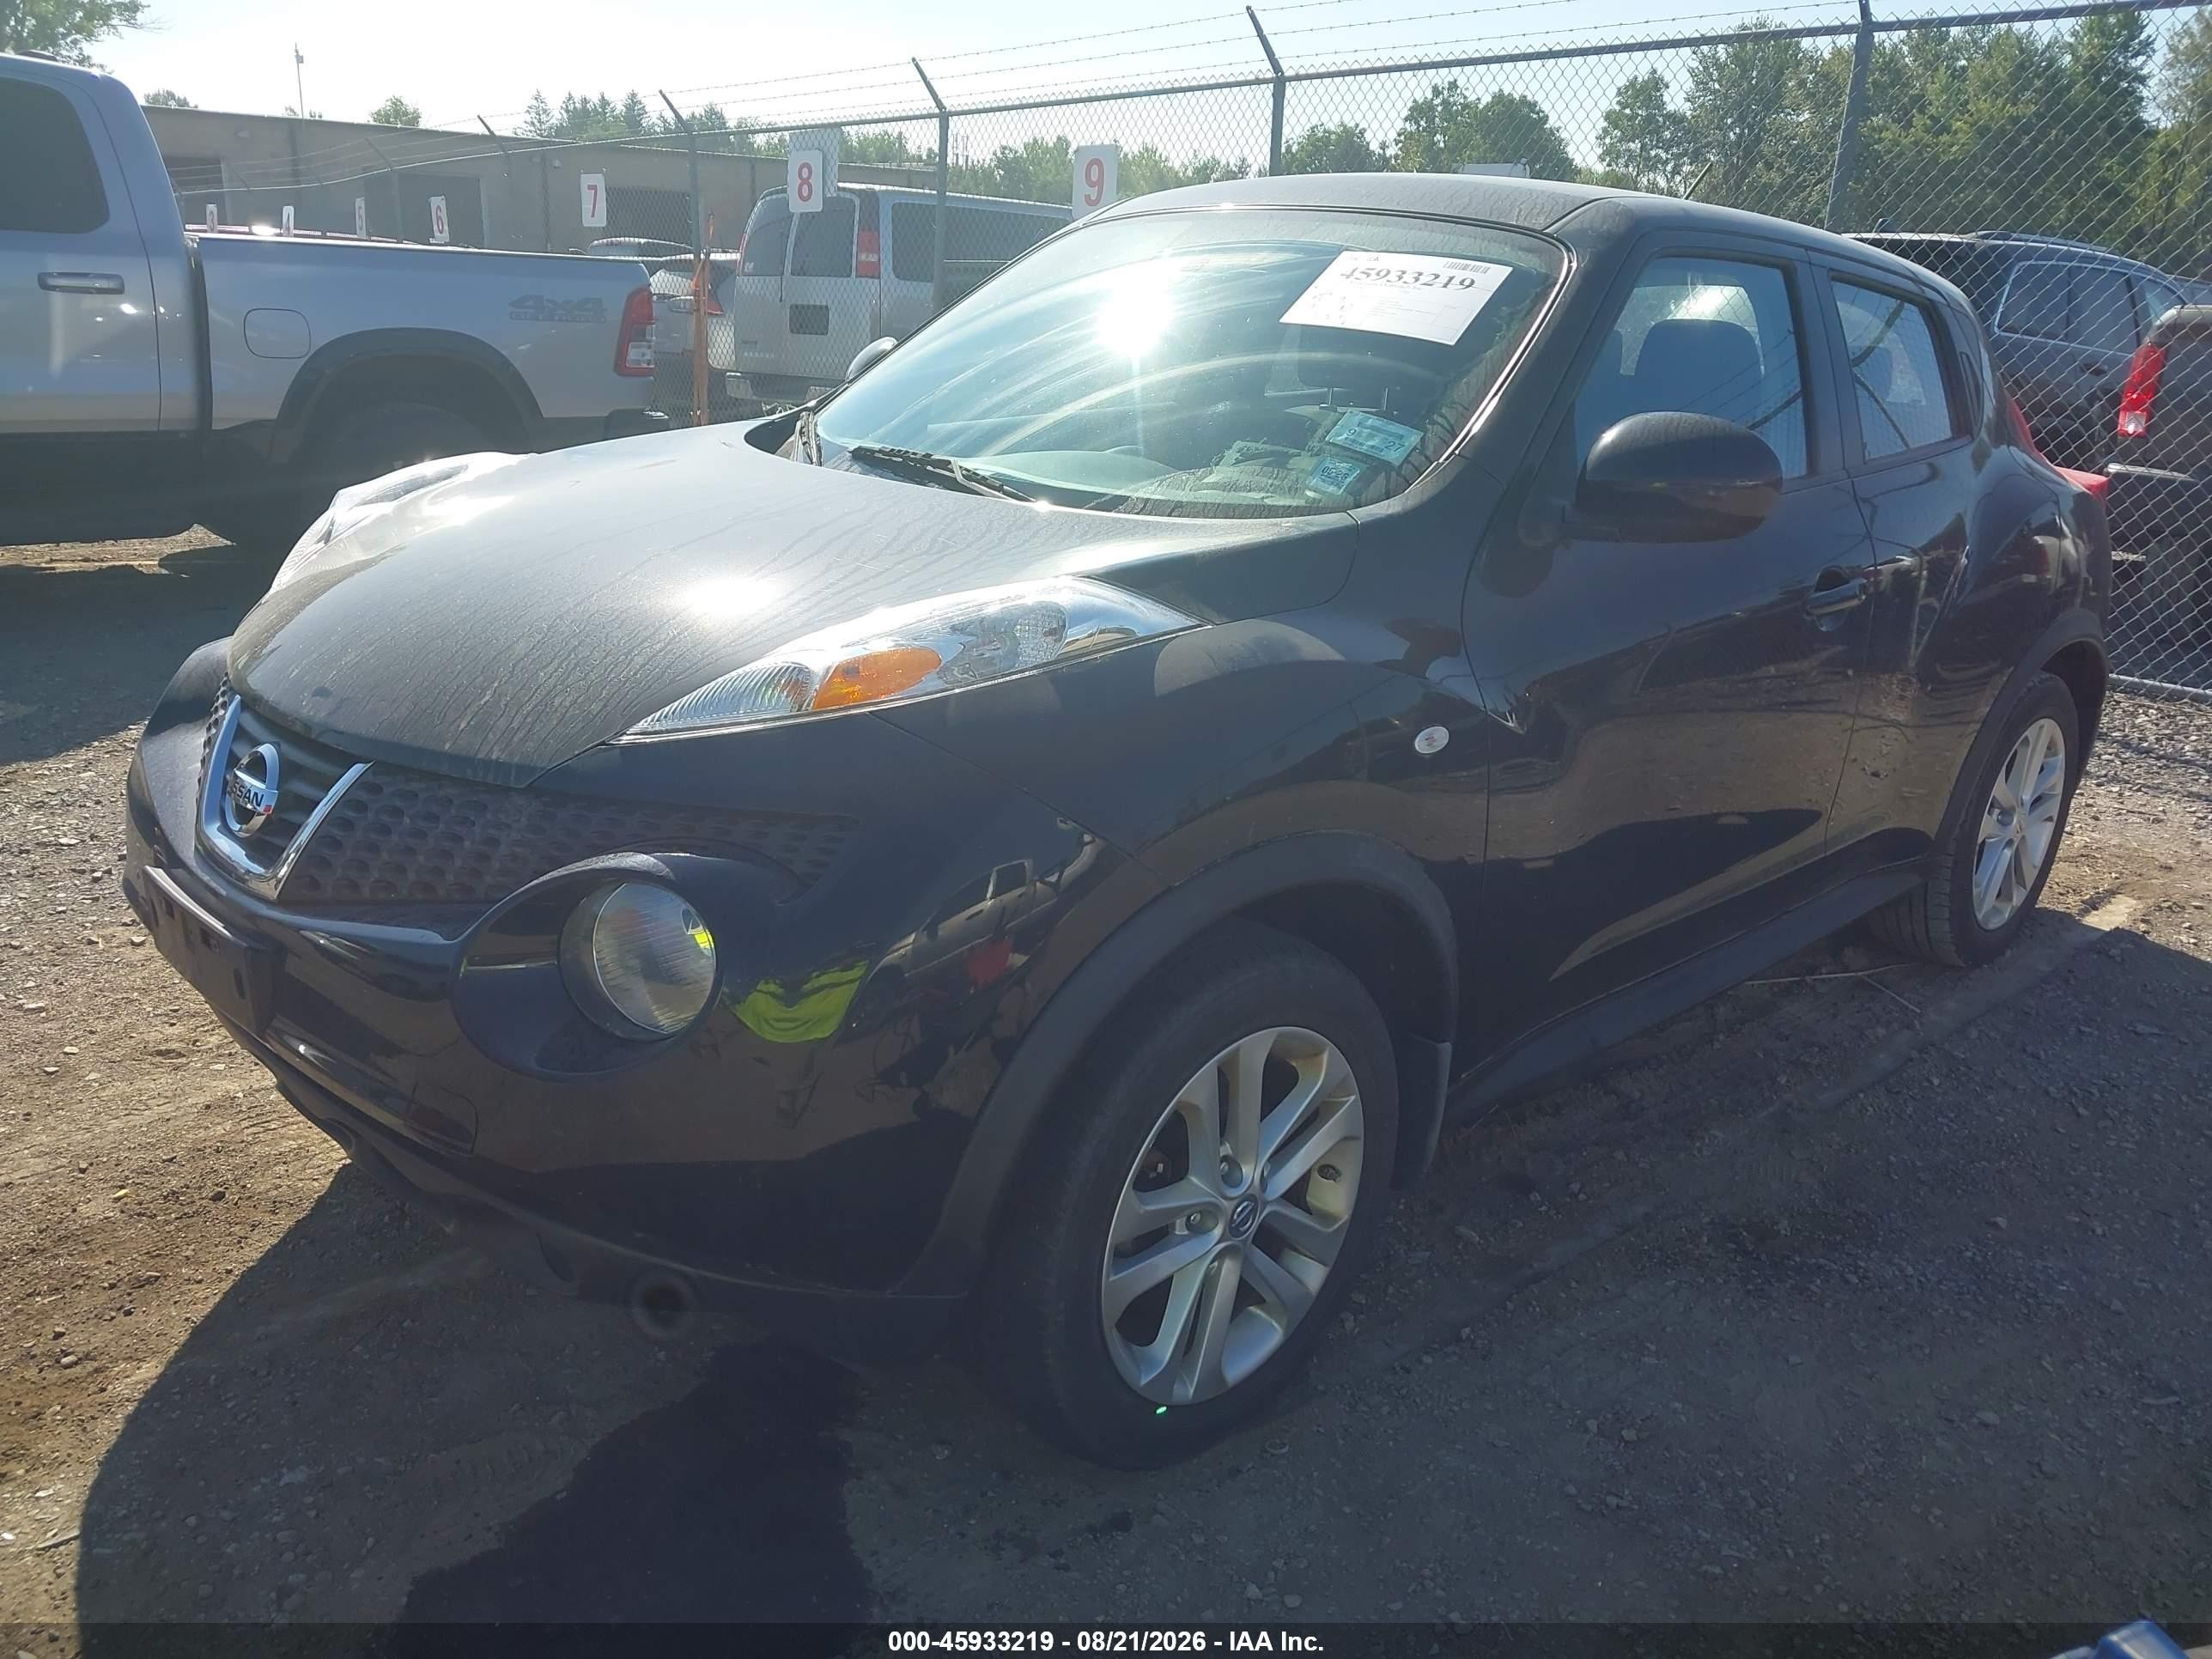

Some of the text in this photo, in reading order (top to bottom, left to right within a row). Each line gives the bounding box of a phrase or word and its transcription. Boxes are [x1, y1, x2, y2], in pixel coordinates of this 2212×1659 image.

[797, 161, 813, 203] 8
[1084, 157, 1105, 207] 9
[586, 184, 599, 218] 7
[285, 211, 291, 237] 4
[357, 205, 364, 231] 5
[434, 204, 444, 234] 6
[1340, 266, 1476, 291] 45933219
[228, 780, 264, 808] SSAN
